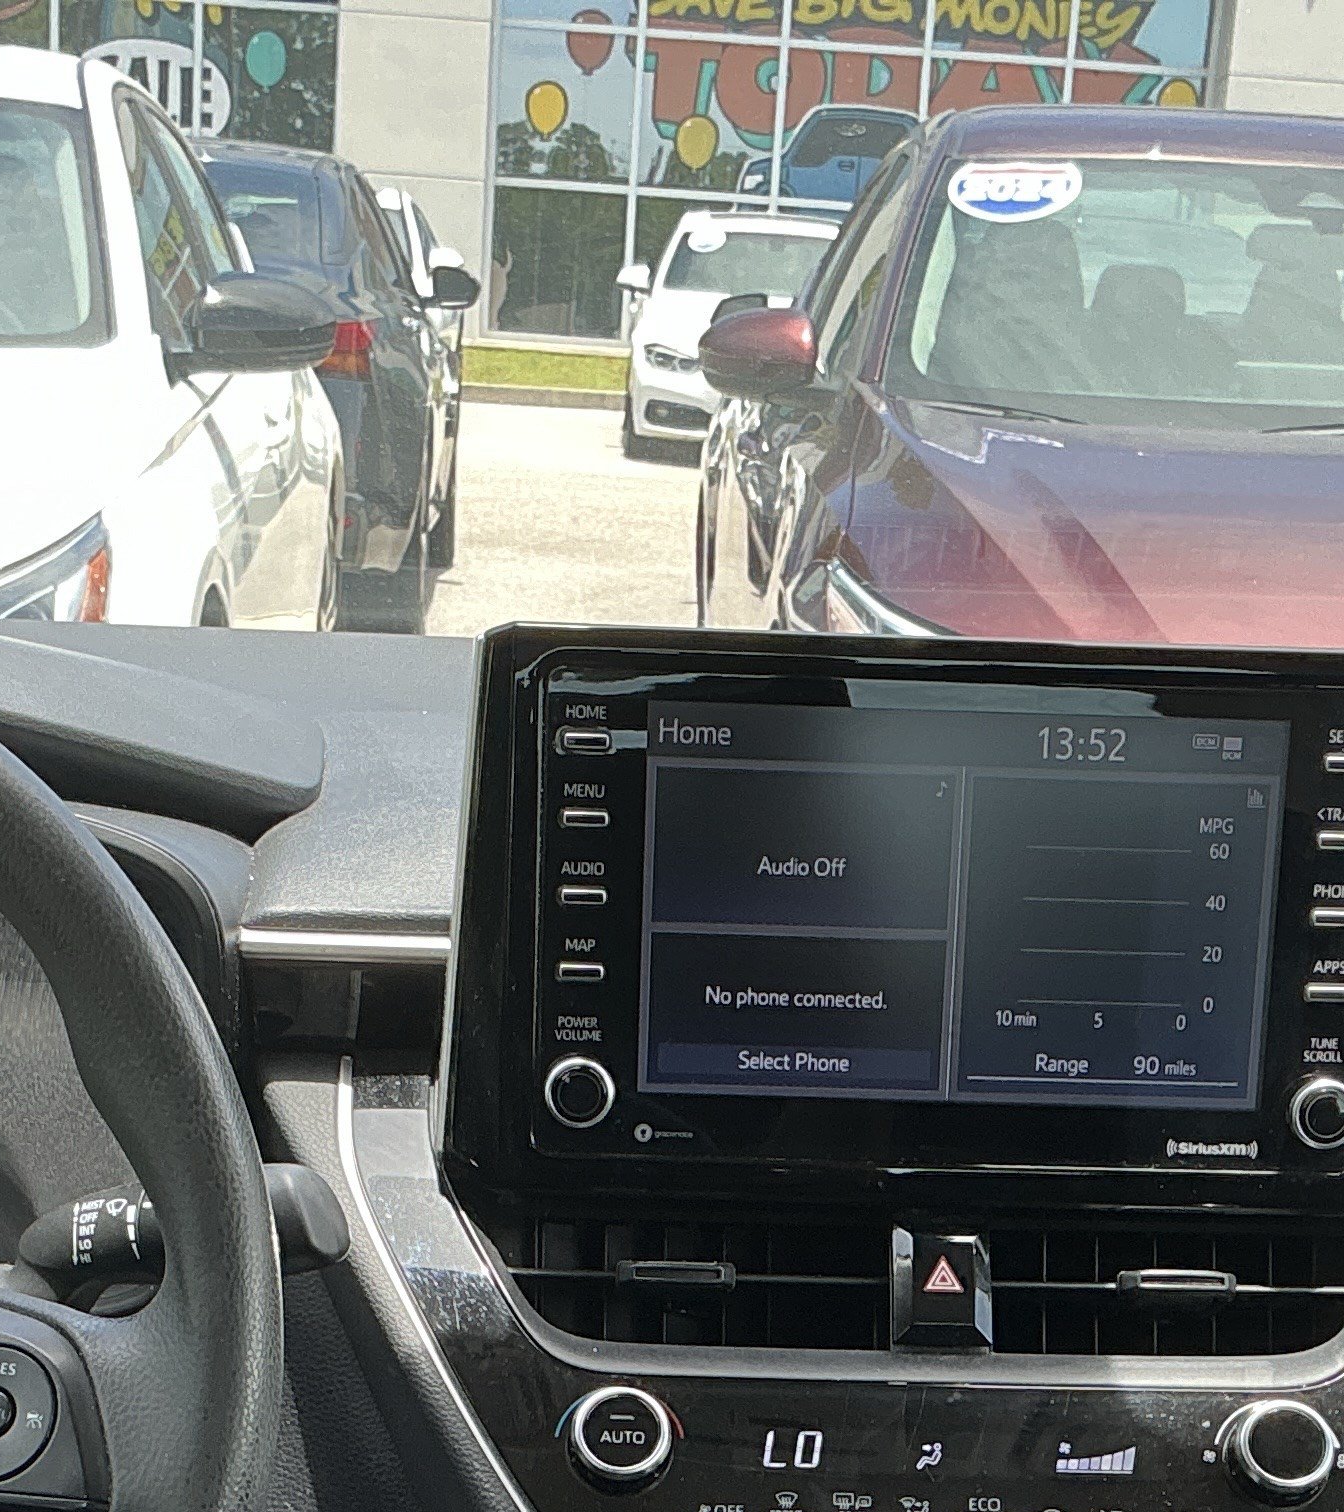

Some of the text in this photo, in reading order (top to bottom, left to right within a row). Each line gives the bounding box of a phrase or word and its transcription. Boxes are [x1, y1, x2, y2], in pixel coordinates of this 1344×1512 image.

[565, 704, 607, 719] HOME
[659, 718, 731, 746] Home
[1038, 727, 1126, 762] 13:52
[563, 783, 605, 798] MENU
[1200, 818, 1234, 835] MPG
[1209, 843, 1230, 861] 60
[561, 861, 605, 876] AUDIO
[757, 857, 846, 877] Audio Off
[1205, 895, 1226, 912] 40
[565, 938, 596, 951] MAP
[1202, 946, 1222, 963] 20
[705, 986, 888, 1010] No phone connected.
[1203, 997, 1214, 1013] 0
[558, 1015, 597, 1028] POWER
[995, 1011, 1037, 1027] 10 min
[1093, 1013, 1103, 1029] 5
[1175, 1014, 1187, 1031] 0
[555, 1029, 602, 1042] VOLUME
[1310, 1037, 1338, 1050] TUNE
[738, 1051, 850, 1072] Select Phone
[1303, 1050, 1343, 1063] SCROLL
[1035, 1053, 1197, 1077] Range 90 miles
[79, 1212, 99, 1223] OFF
[79, 1224, 96, 1236] INT
[78, 1238, 92, 1250] LO
[600, 1430, 645, 1446] AUTO
[763, 1430, 823, 1468] LO
[969, 1498, 1001, 1512] ECO
